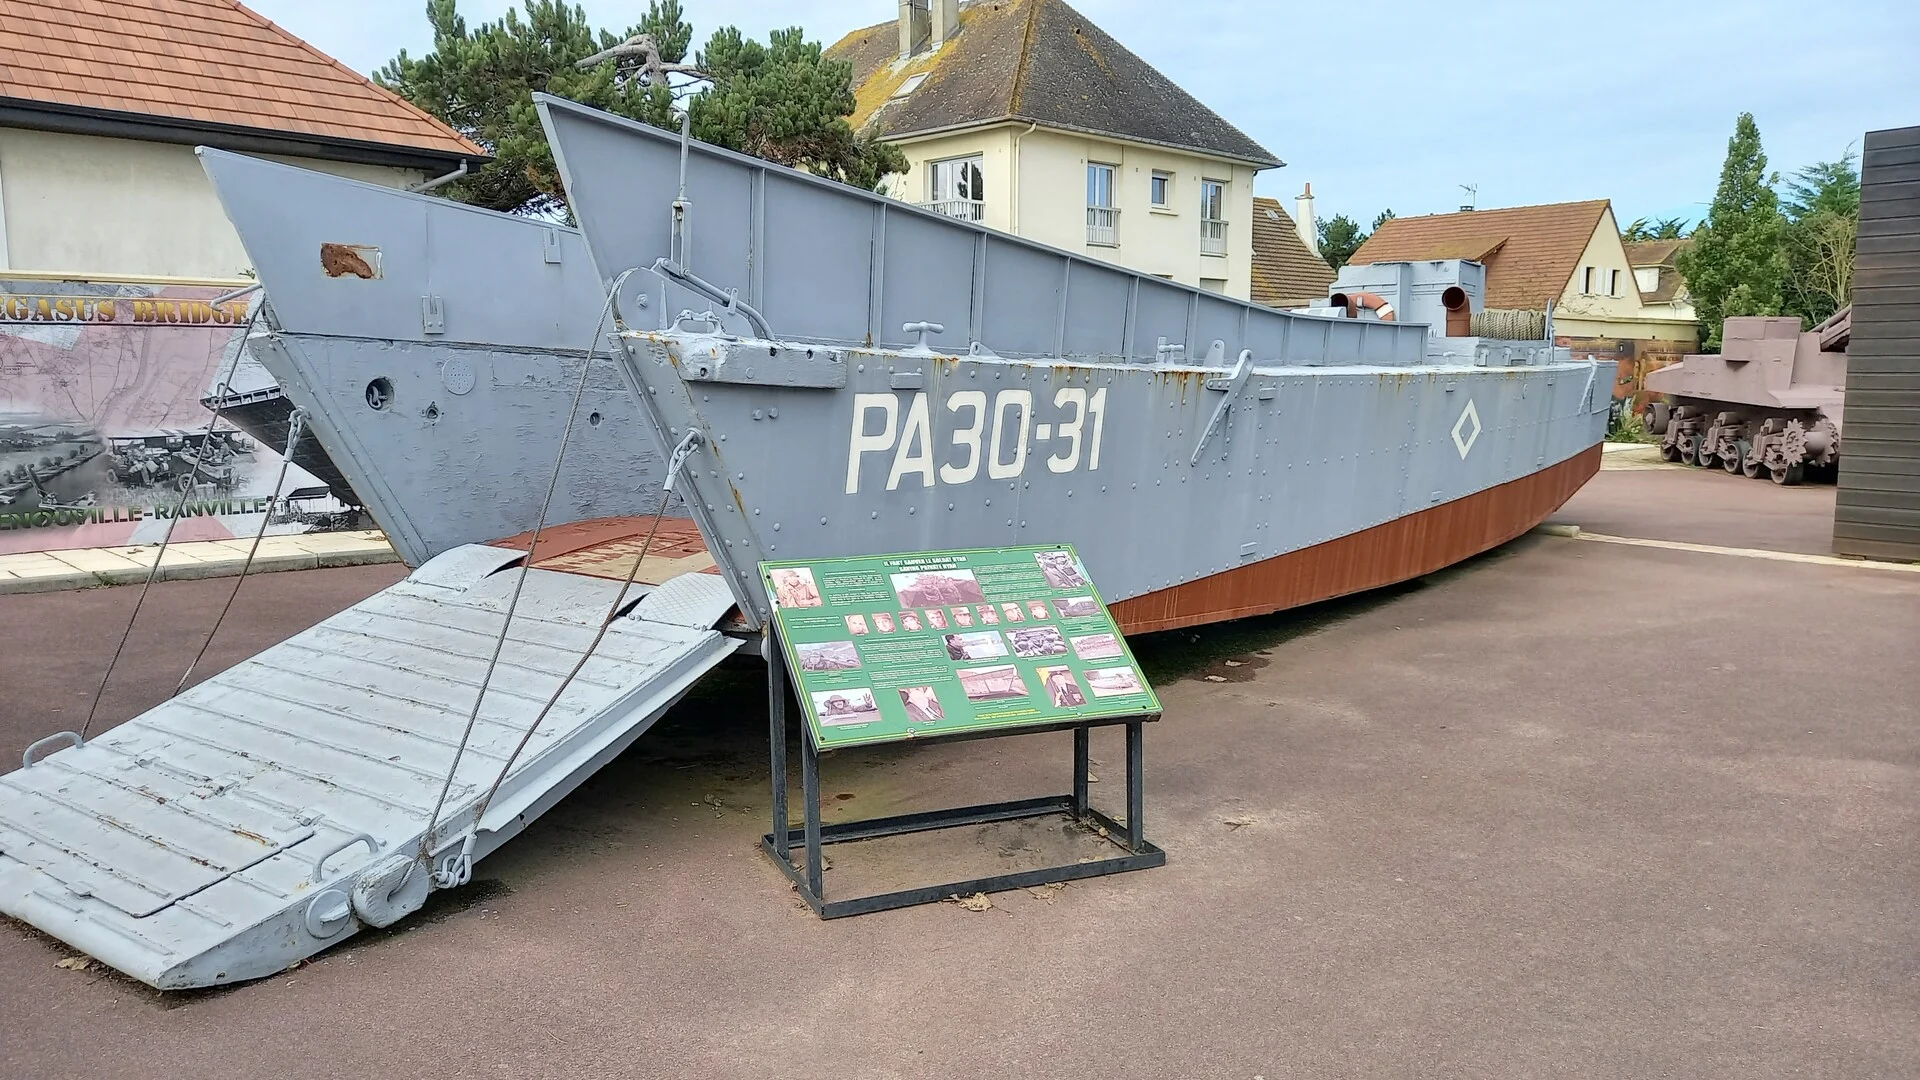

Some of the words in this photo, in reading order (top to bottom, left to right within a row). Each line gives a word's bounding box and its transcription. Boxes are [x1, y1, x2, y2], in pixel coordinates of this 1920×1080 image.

[0, 297, 116, 322] GASUS
[132, 300, 249, 325] BRIDGE
[845, 387, 1107, 495] PA30-31
